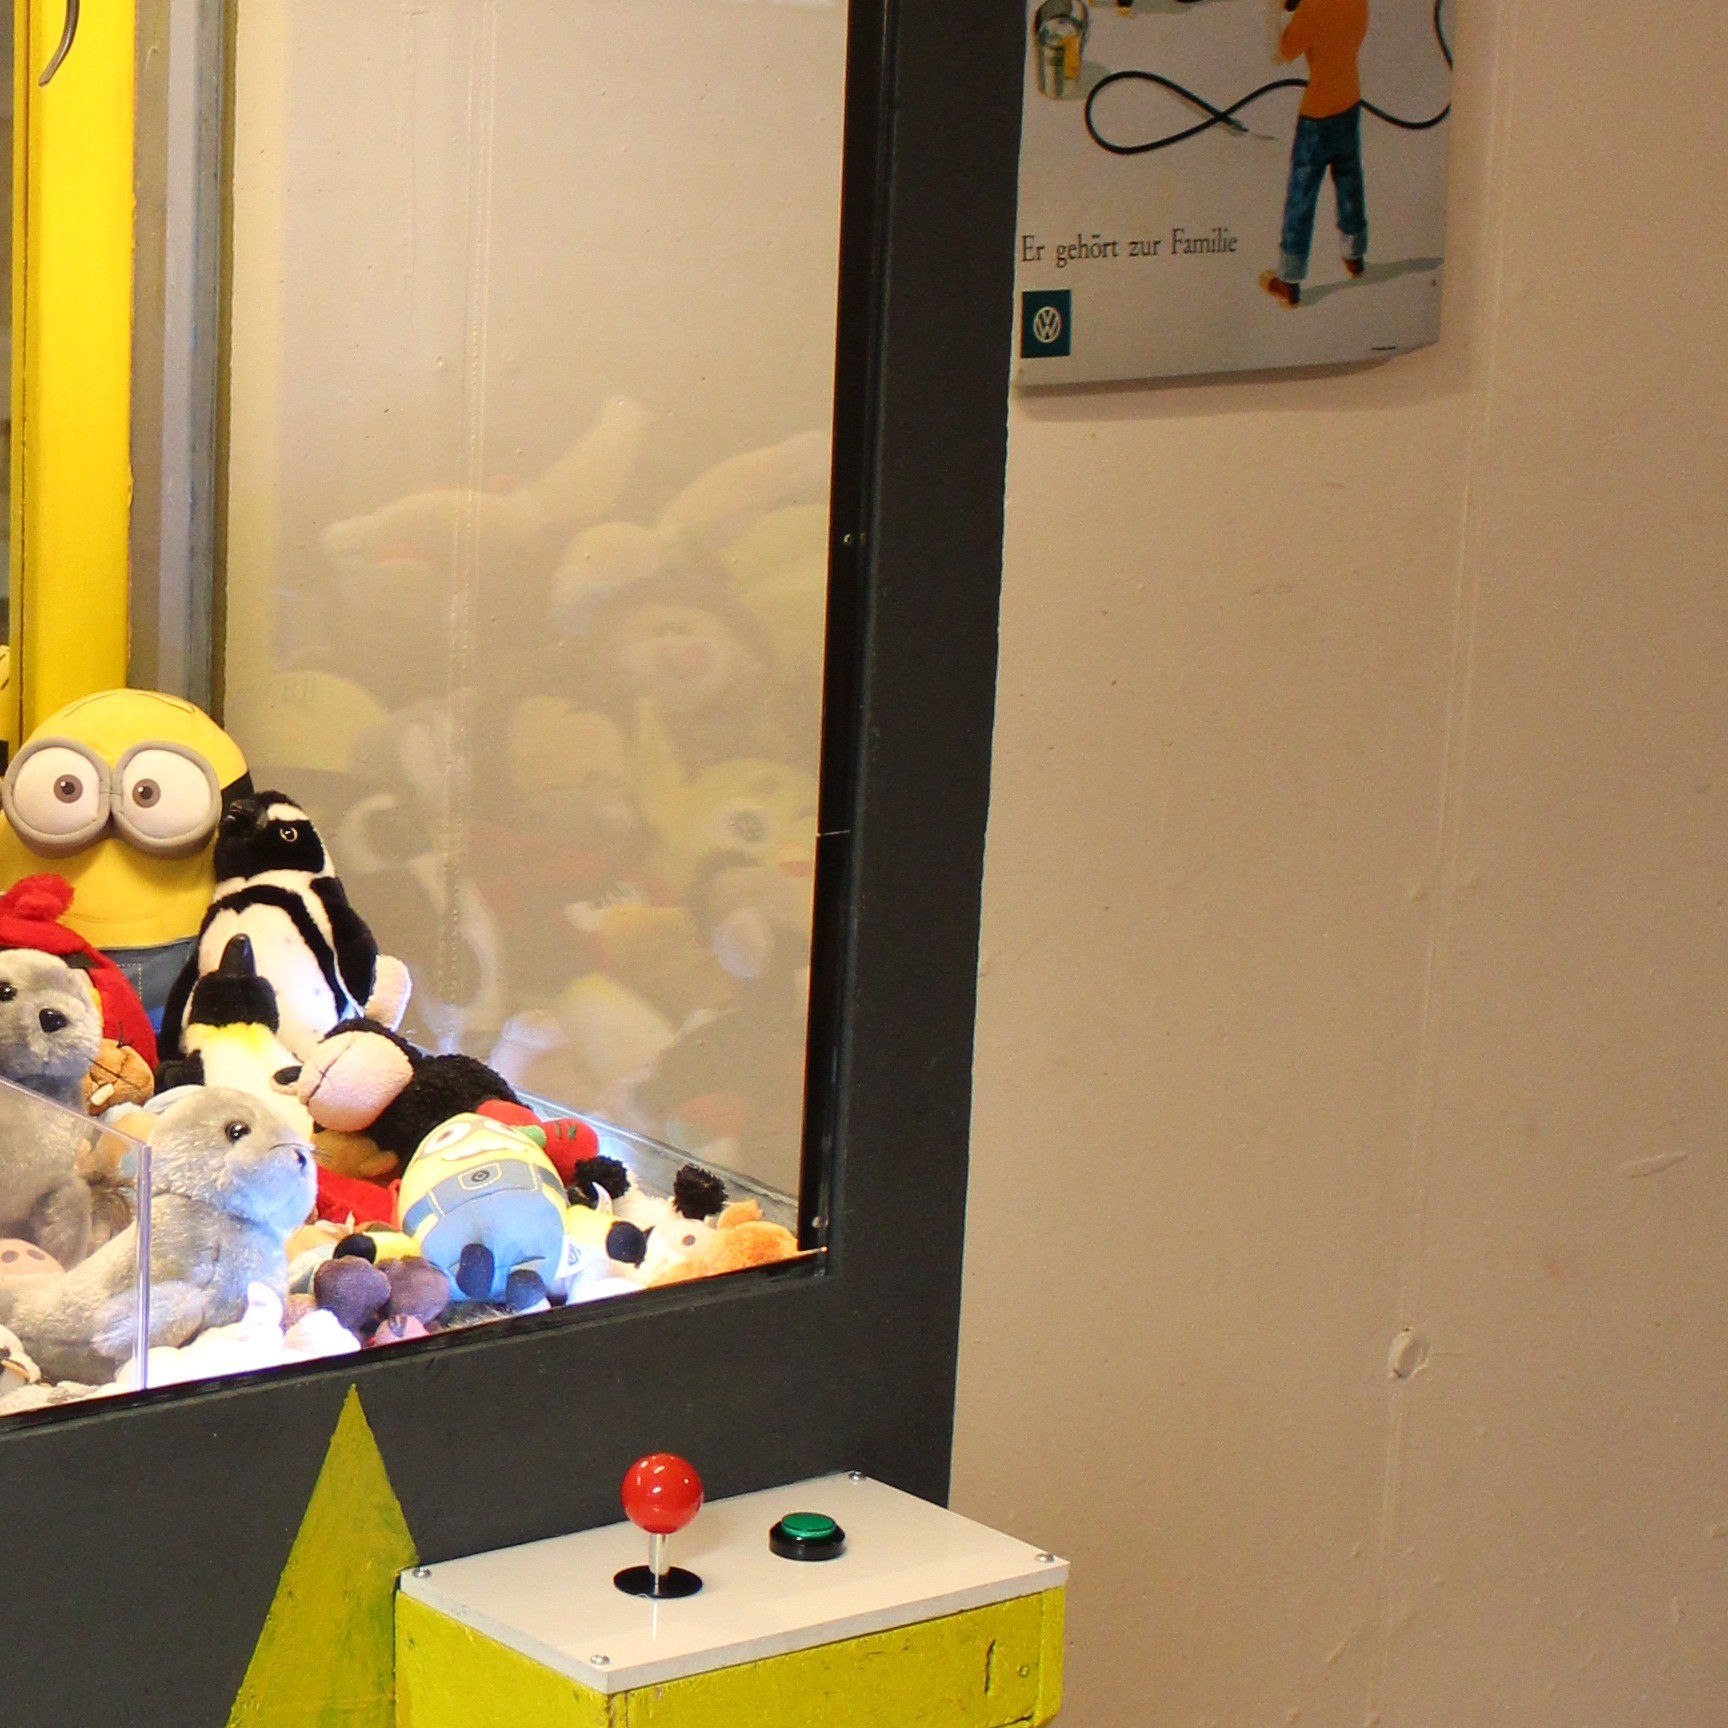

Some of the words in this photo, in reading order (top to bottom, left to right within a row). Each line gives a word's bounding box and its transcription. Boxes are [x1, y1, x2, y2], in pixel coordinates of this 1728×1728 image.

[1021, 234, 1045, 262] Er
[1056, 233, 1119, 268] gehört
[1128, 239, 1162, 257] zur
[1171, 227, 1238, 255] Familie
[1034, 306, 1061, 343] VW
